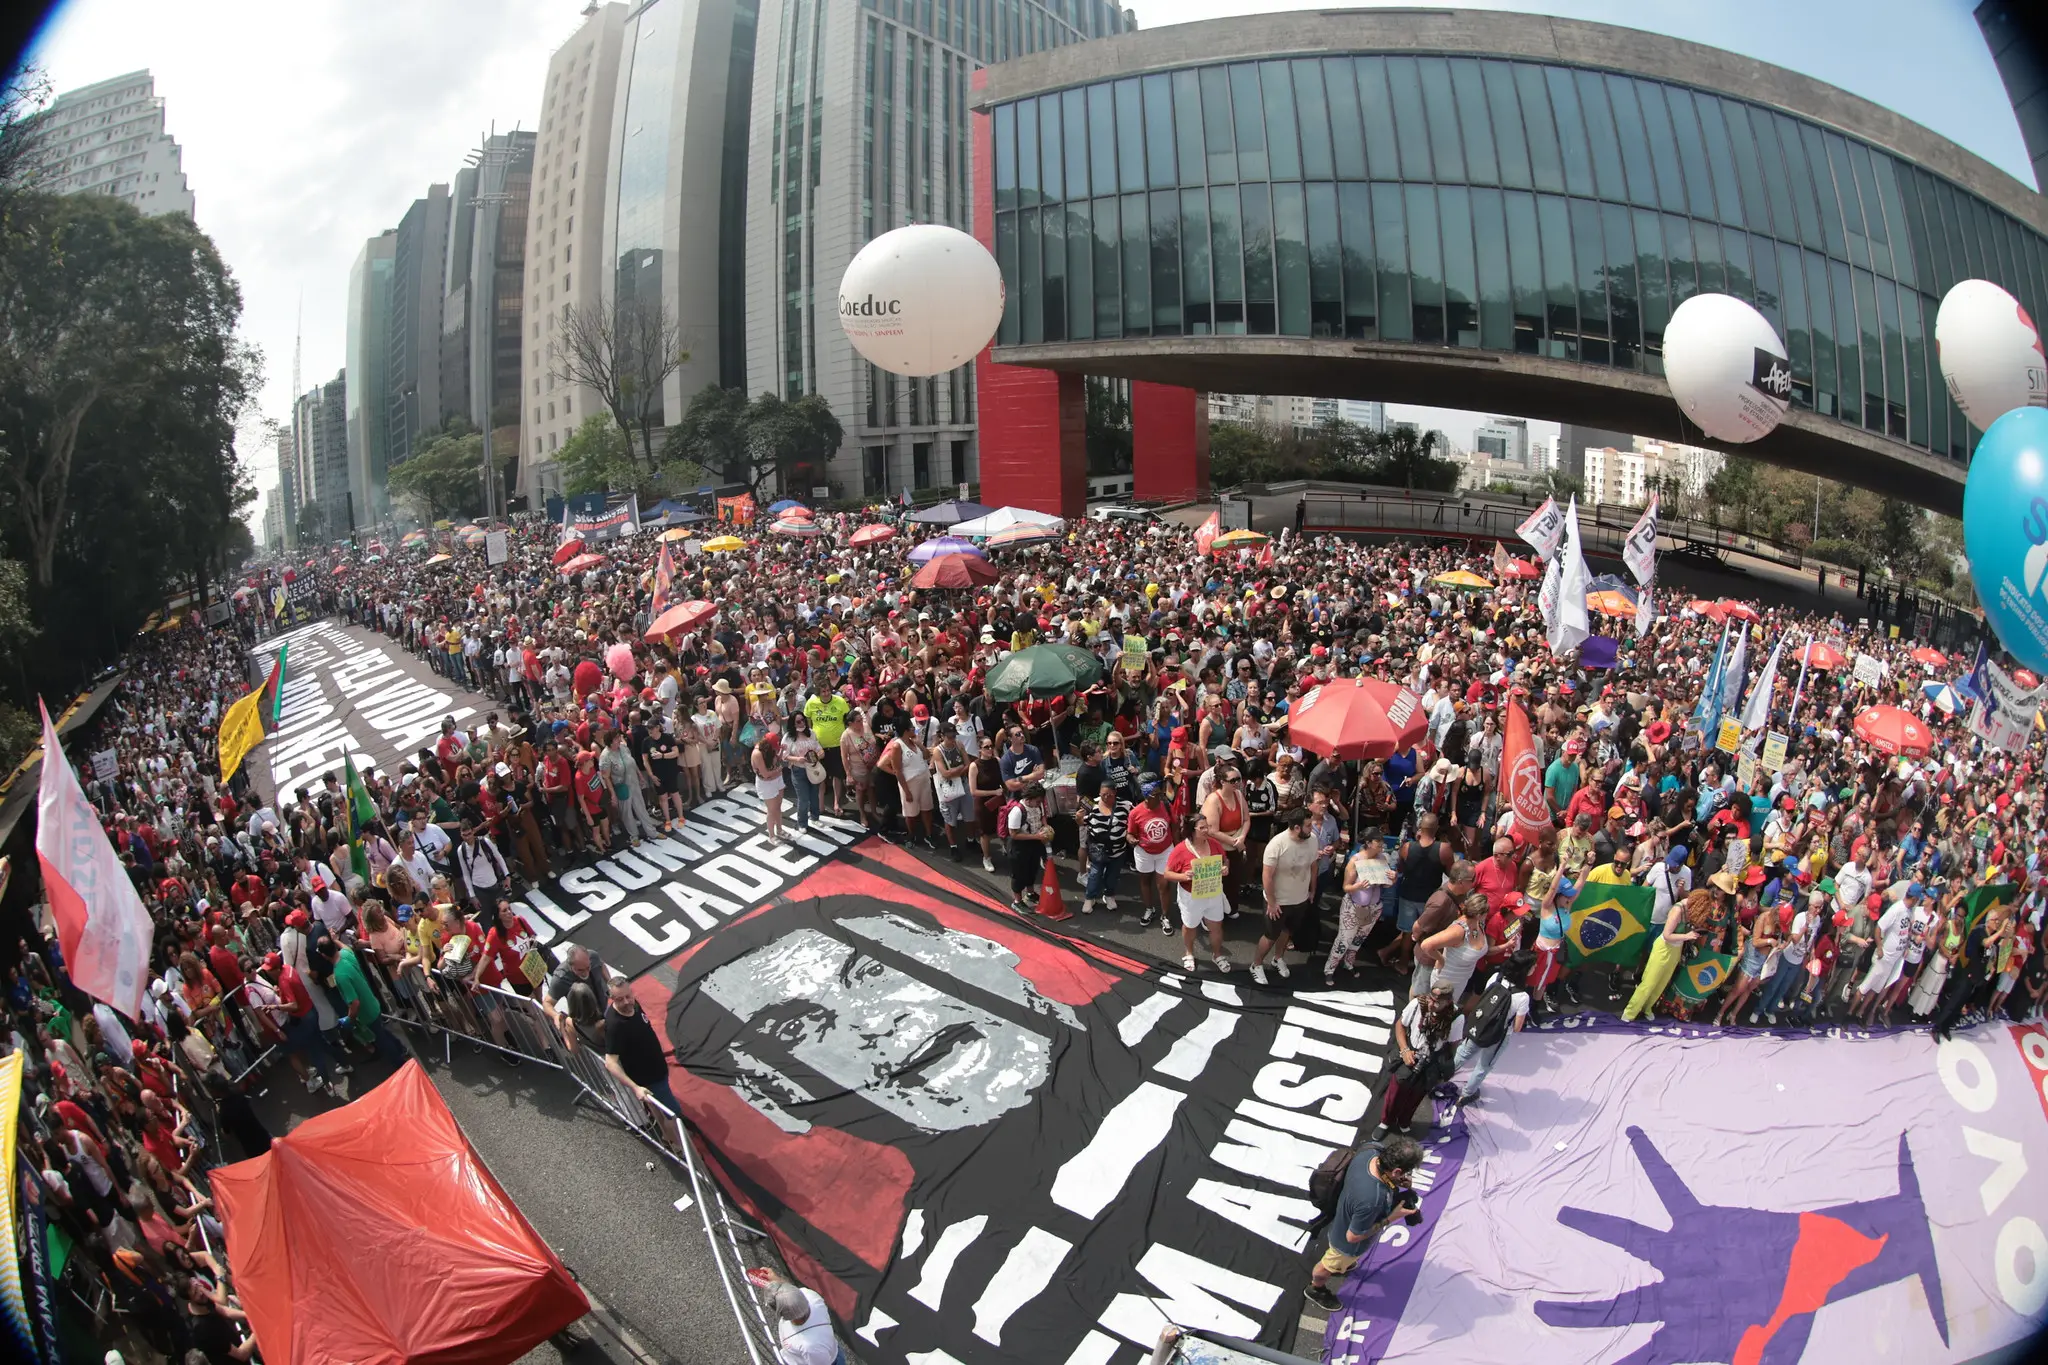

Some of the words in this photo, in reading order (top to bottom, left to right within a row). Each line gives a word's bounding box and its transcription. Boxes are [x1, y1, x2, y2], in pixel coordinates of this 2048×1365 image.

[2002, 575, 2033, 614] SINDICATO
[1517, 795, 1545, 819] BRASIL
[518, 941, 530, 952] PT
[36, 1284, 58, 1343] CANA
